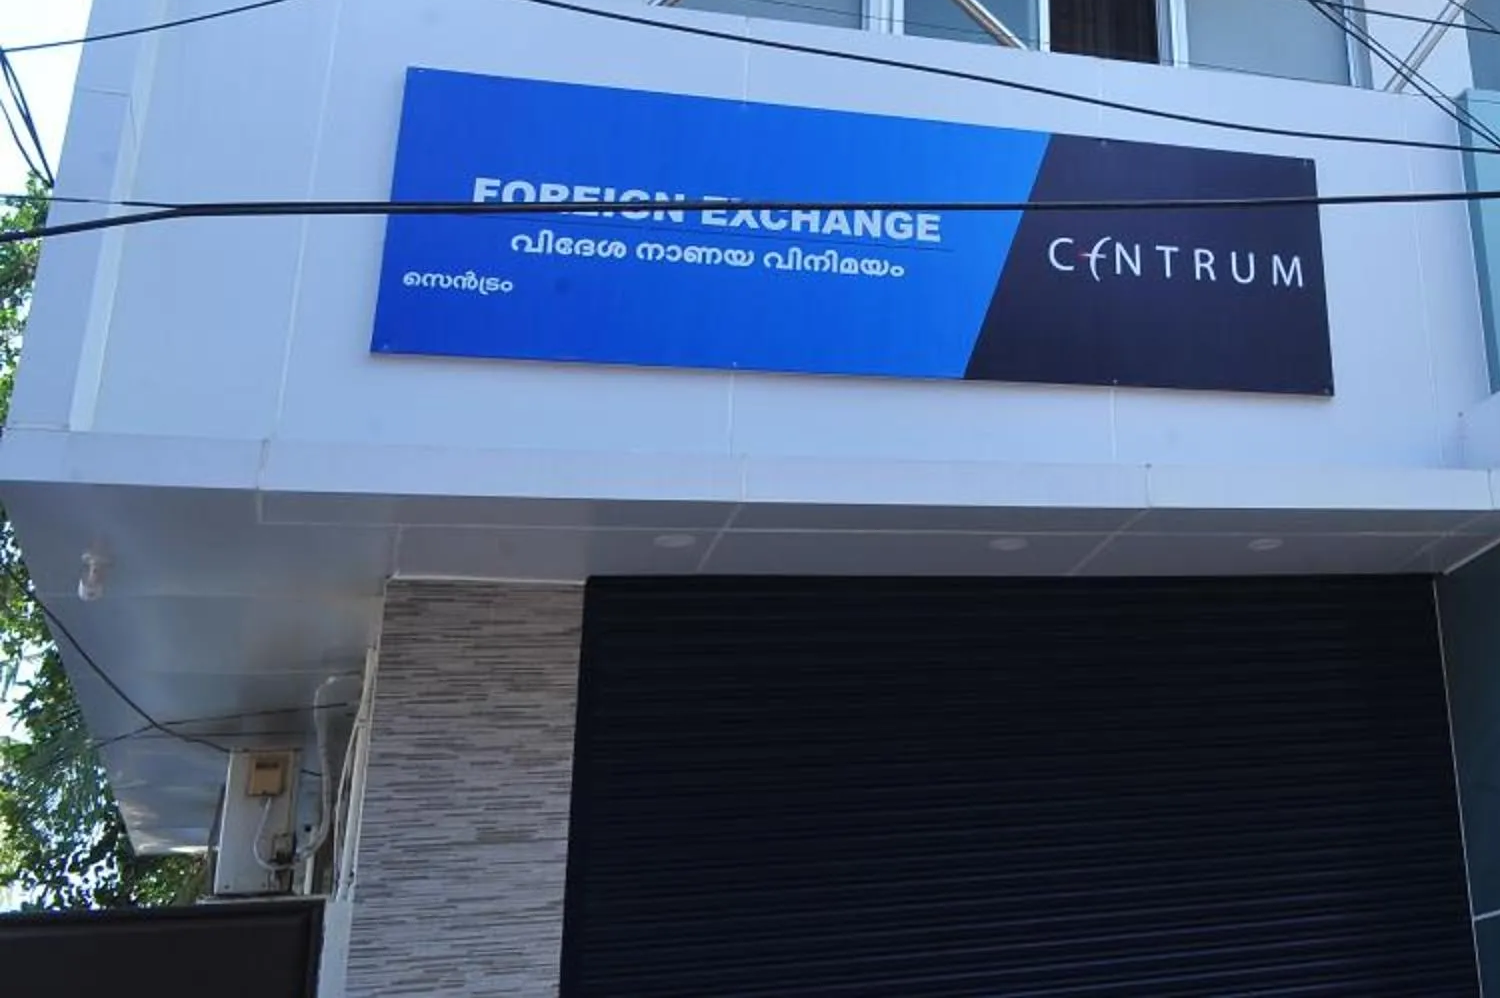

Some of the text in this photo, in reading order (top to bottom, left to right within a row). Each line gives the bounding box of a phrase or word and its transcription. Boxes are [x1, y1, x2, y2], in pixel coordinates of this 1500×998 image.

[472, 176, 942, 243] FOREIGN EXCHANGE
[510, 229, 905, 278] വിദേശ നാണയ വിനിമയം
[1048, 236, 1304, 288] CENTRUM
